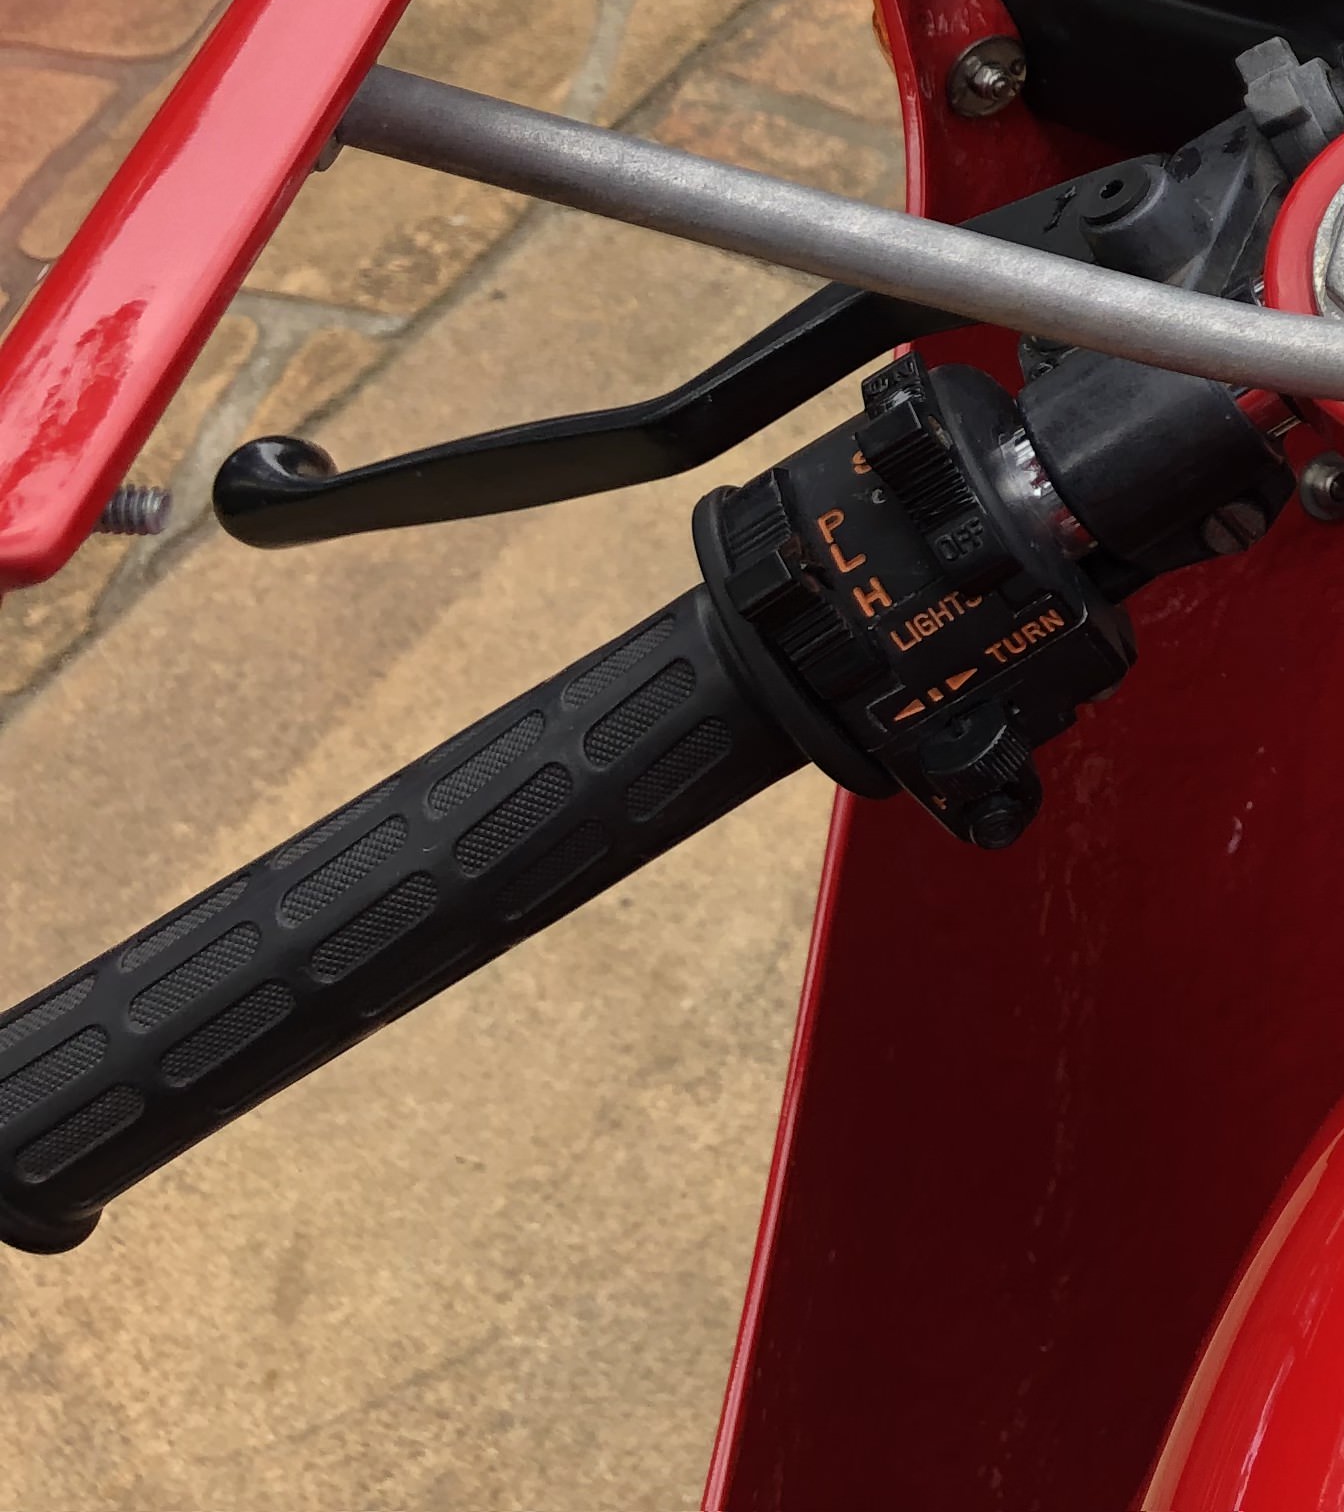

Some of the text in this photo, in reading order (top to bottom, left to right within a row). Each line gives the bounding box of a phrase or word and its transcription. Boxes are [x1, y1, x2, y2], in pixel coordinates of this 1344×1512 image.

[817, 507, 845, 544] P
[830, 543, 867, 573] L
[852, 576, 893, 618] H
[984, 608, 1065, 663] TURN
